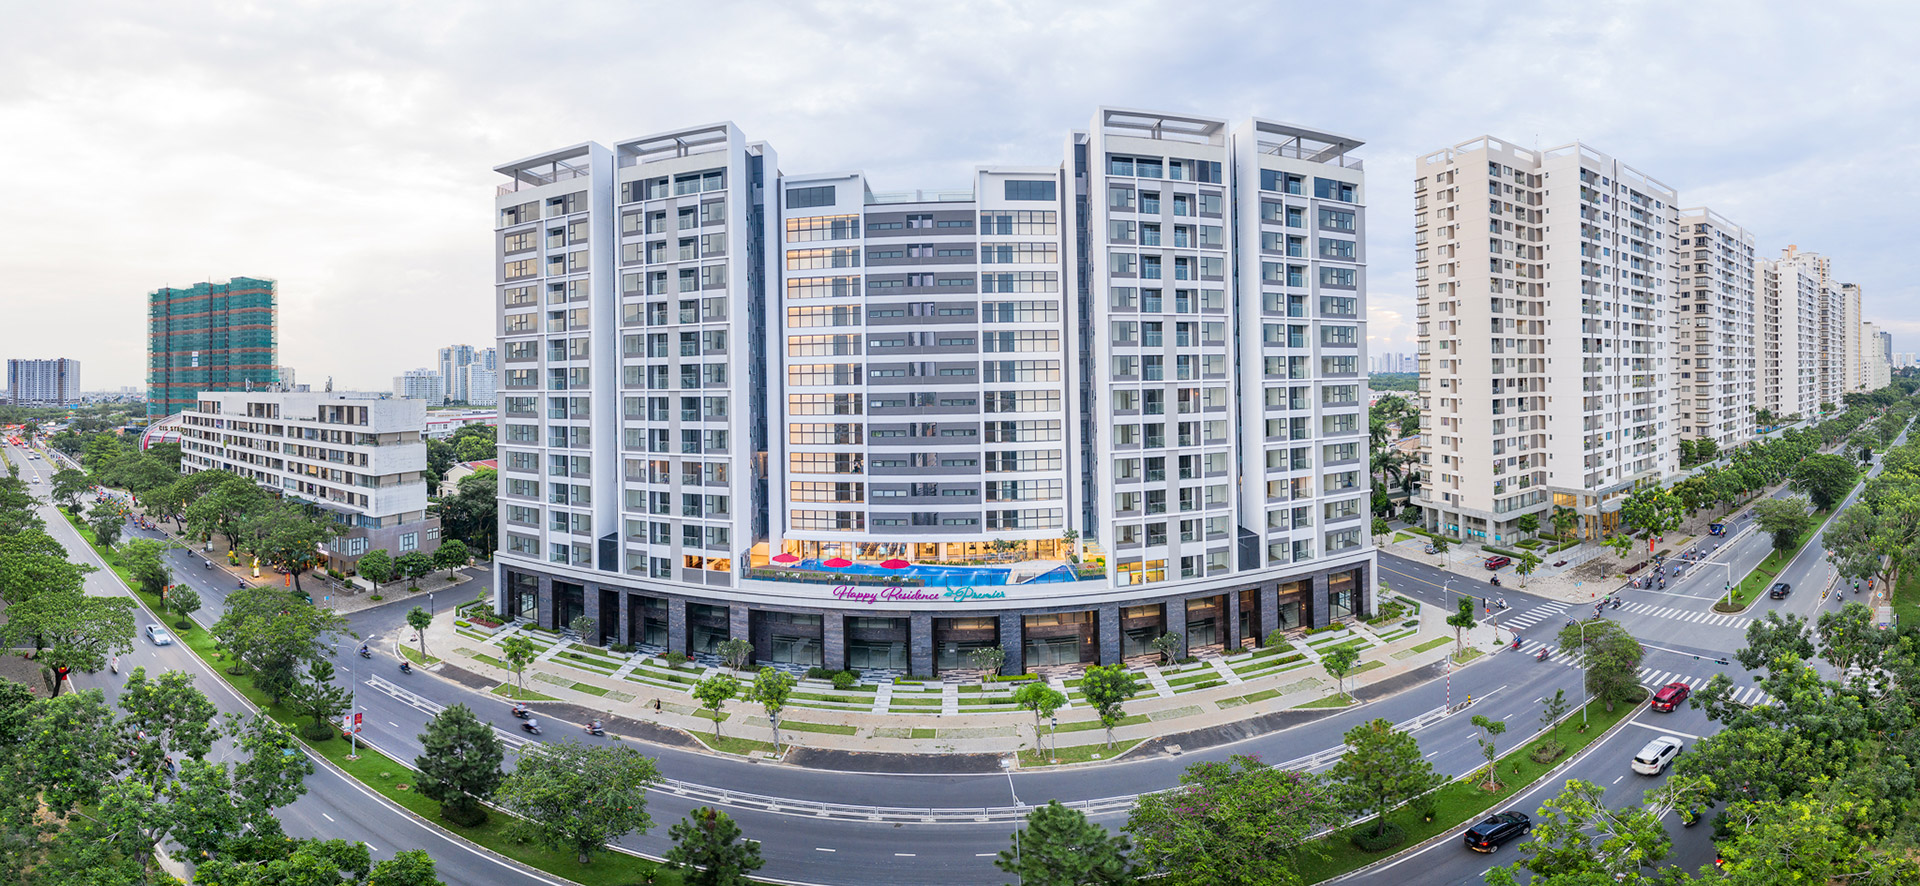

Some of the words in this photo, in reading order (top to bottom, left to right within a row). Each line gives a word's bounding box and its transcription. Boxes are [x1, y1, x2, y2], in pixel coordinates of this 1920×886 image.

[833, 585, 878, 604] Happy
[880, 586, 939, 601] Residence
[954, 586, 1006, 602] Premier
